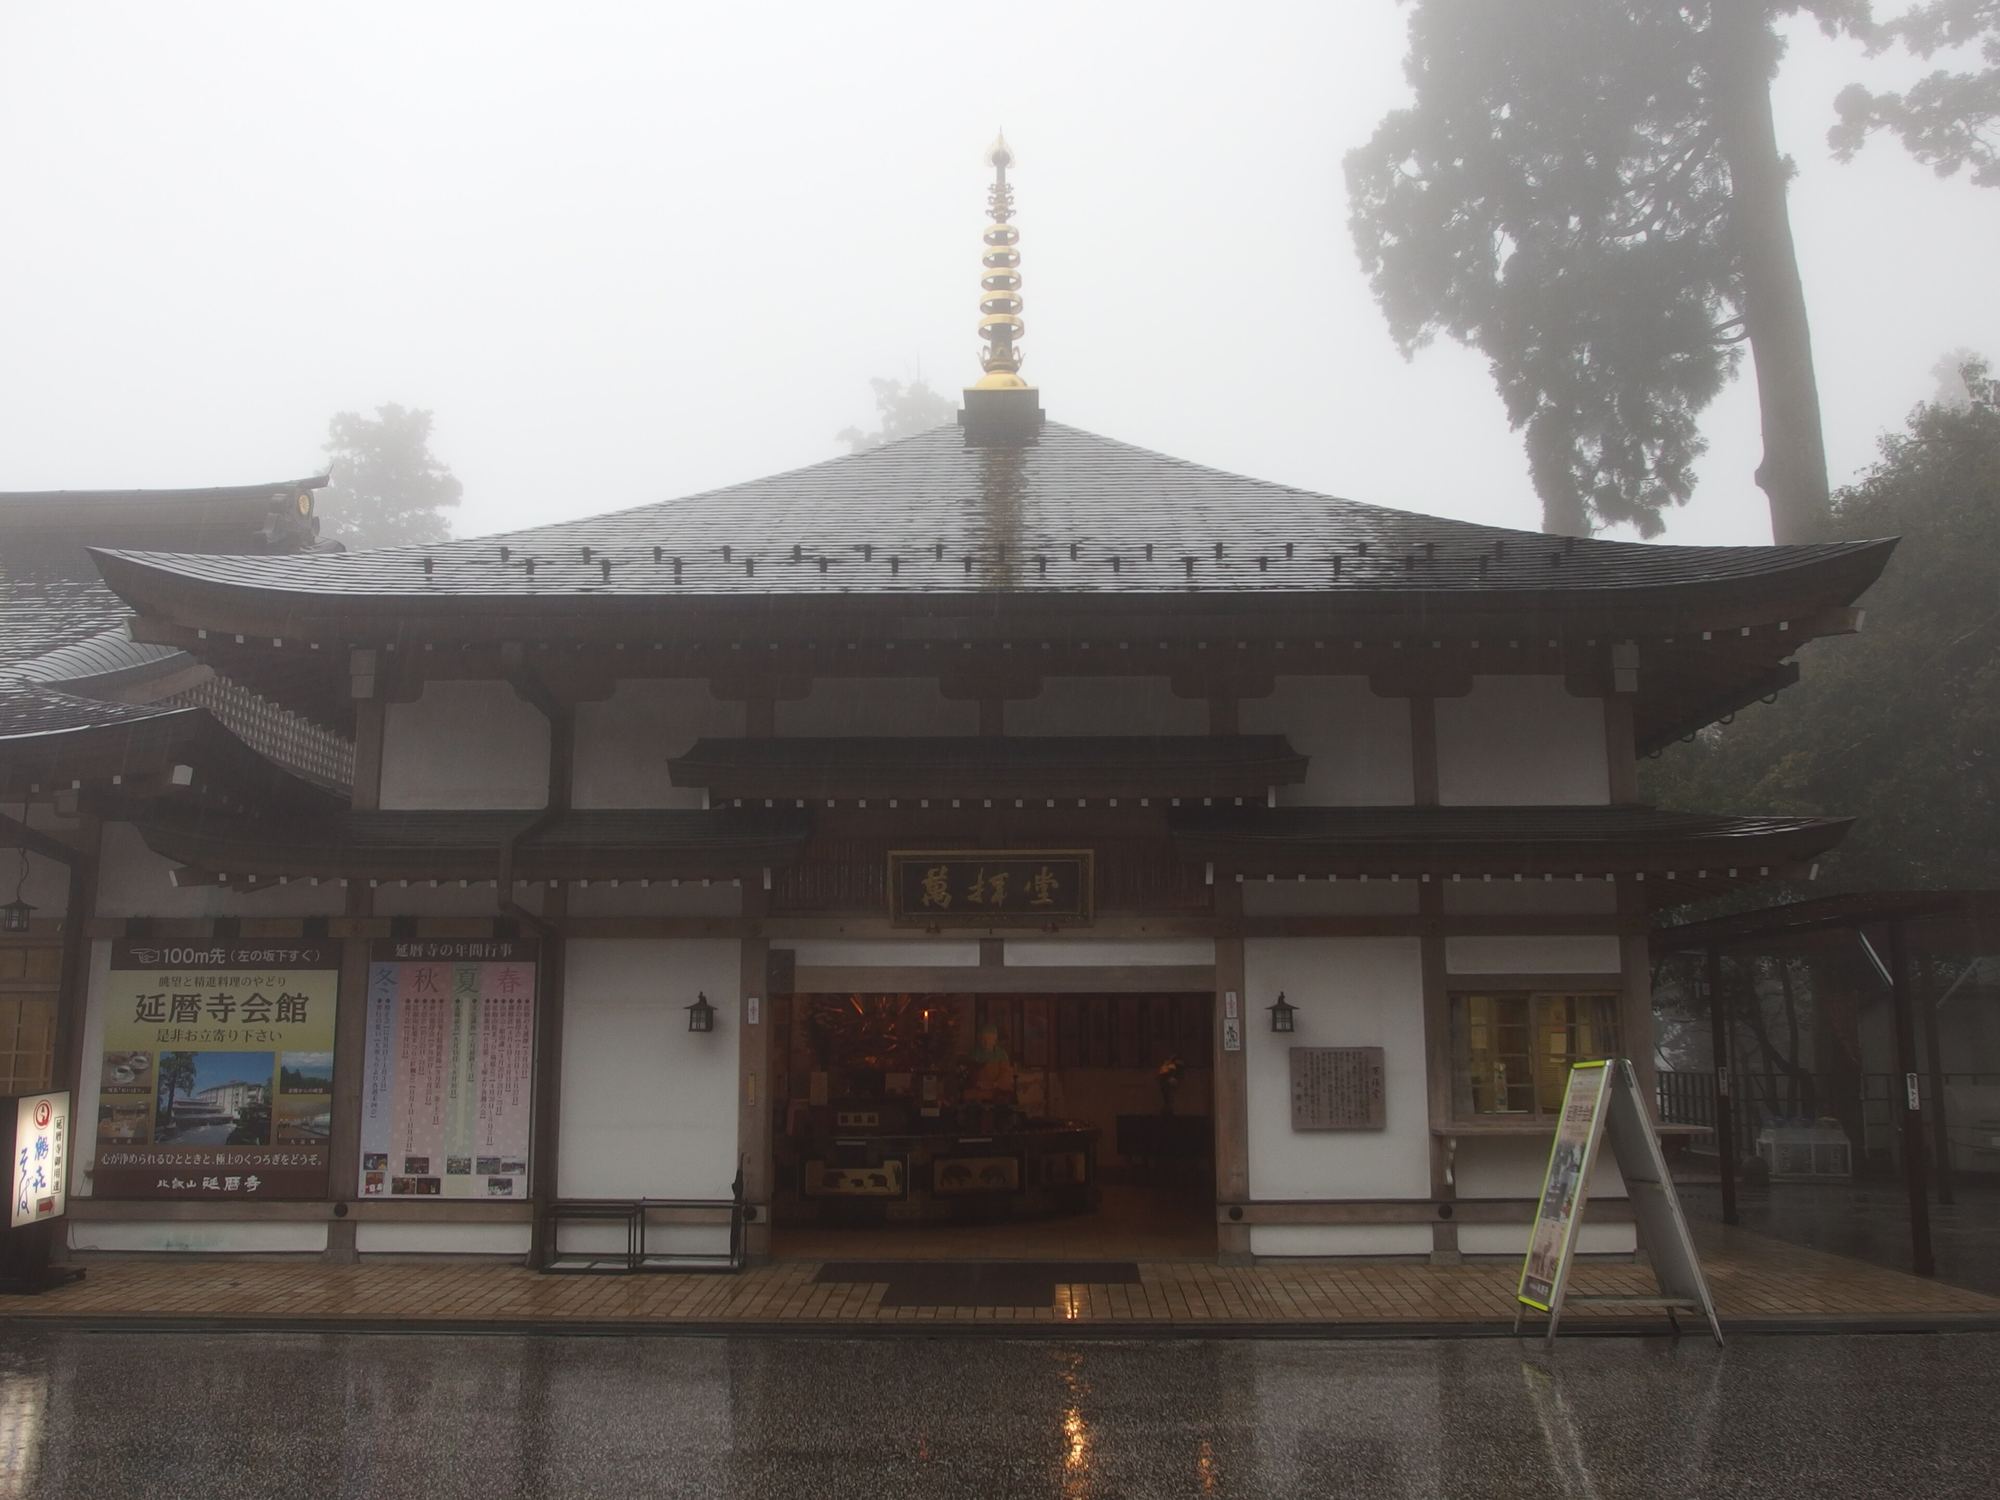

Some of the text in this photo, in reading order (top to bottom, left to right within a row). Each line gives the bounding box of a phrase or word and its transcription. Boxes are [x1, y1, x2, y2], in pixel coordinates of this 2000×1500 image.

[394, 942, 514, 958] 延暦寺の年間行事
[158, 975, 287, 988] 眺望と精進料理のやどり
[374, 967, 399, 994] 冬
[411, 966, 440, 994] 秋
[454, 967, 480, 994] 夏
[497, 966, 522, 994] 春
[133, 992, 310, 1024] 延暦寺会館
[156, 1028, 283, 1043] 是非お立寄り下さい
[202, 1174, 263, 1193] 延暦寺
